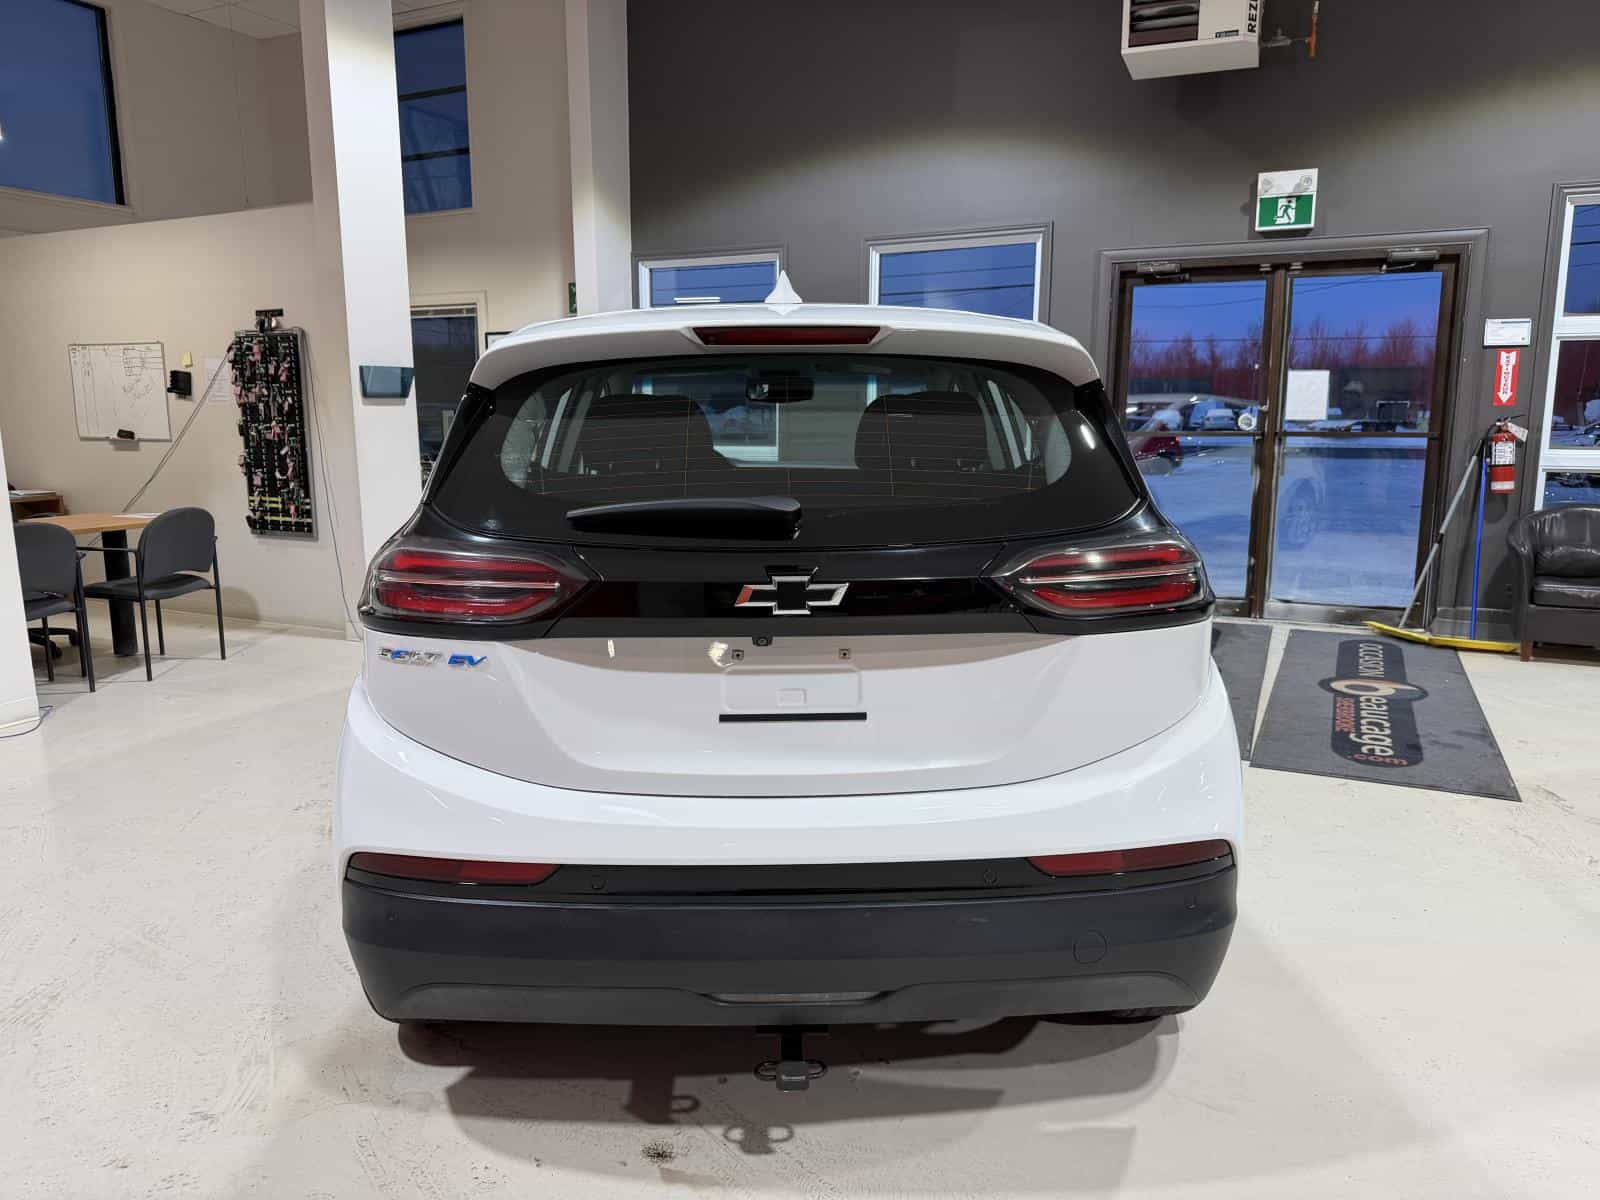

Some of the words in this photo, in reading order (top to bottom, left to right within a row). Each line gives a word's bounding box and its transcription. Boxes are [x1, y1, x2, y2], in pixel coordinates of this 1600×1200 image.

[1247, 0, 1258, 33] REZ
[447, 655, 488, 667] EV
[1358, 643, 1385, 678] OCCASION
